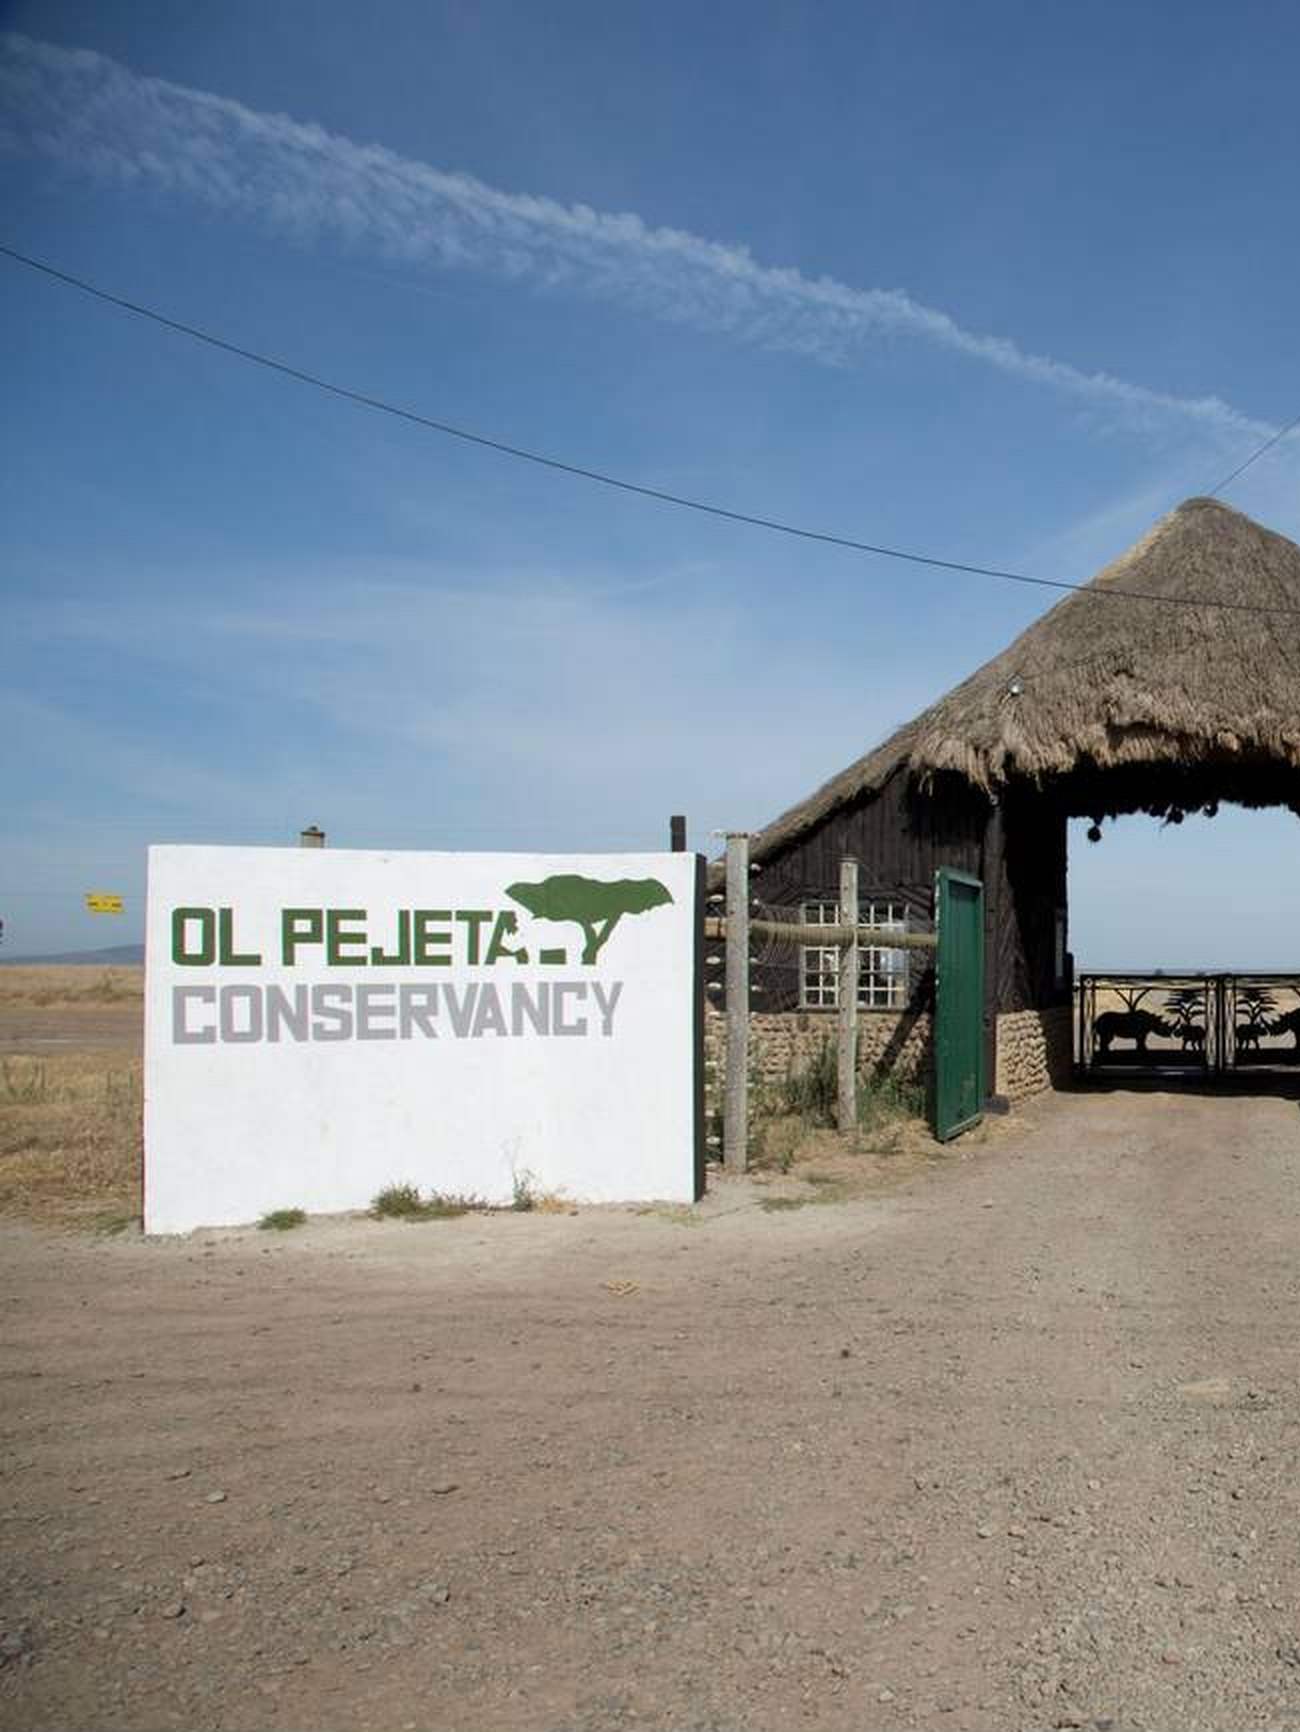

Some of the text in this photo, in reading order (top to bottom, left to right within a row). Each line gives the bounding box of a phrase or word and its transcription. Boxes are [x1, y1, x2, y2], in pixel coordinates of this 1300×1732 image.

[171, 907, 529, 967] OL PEJETA
[172, 981, 624, 1045] CONSERVANCY
